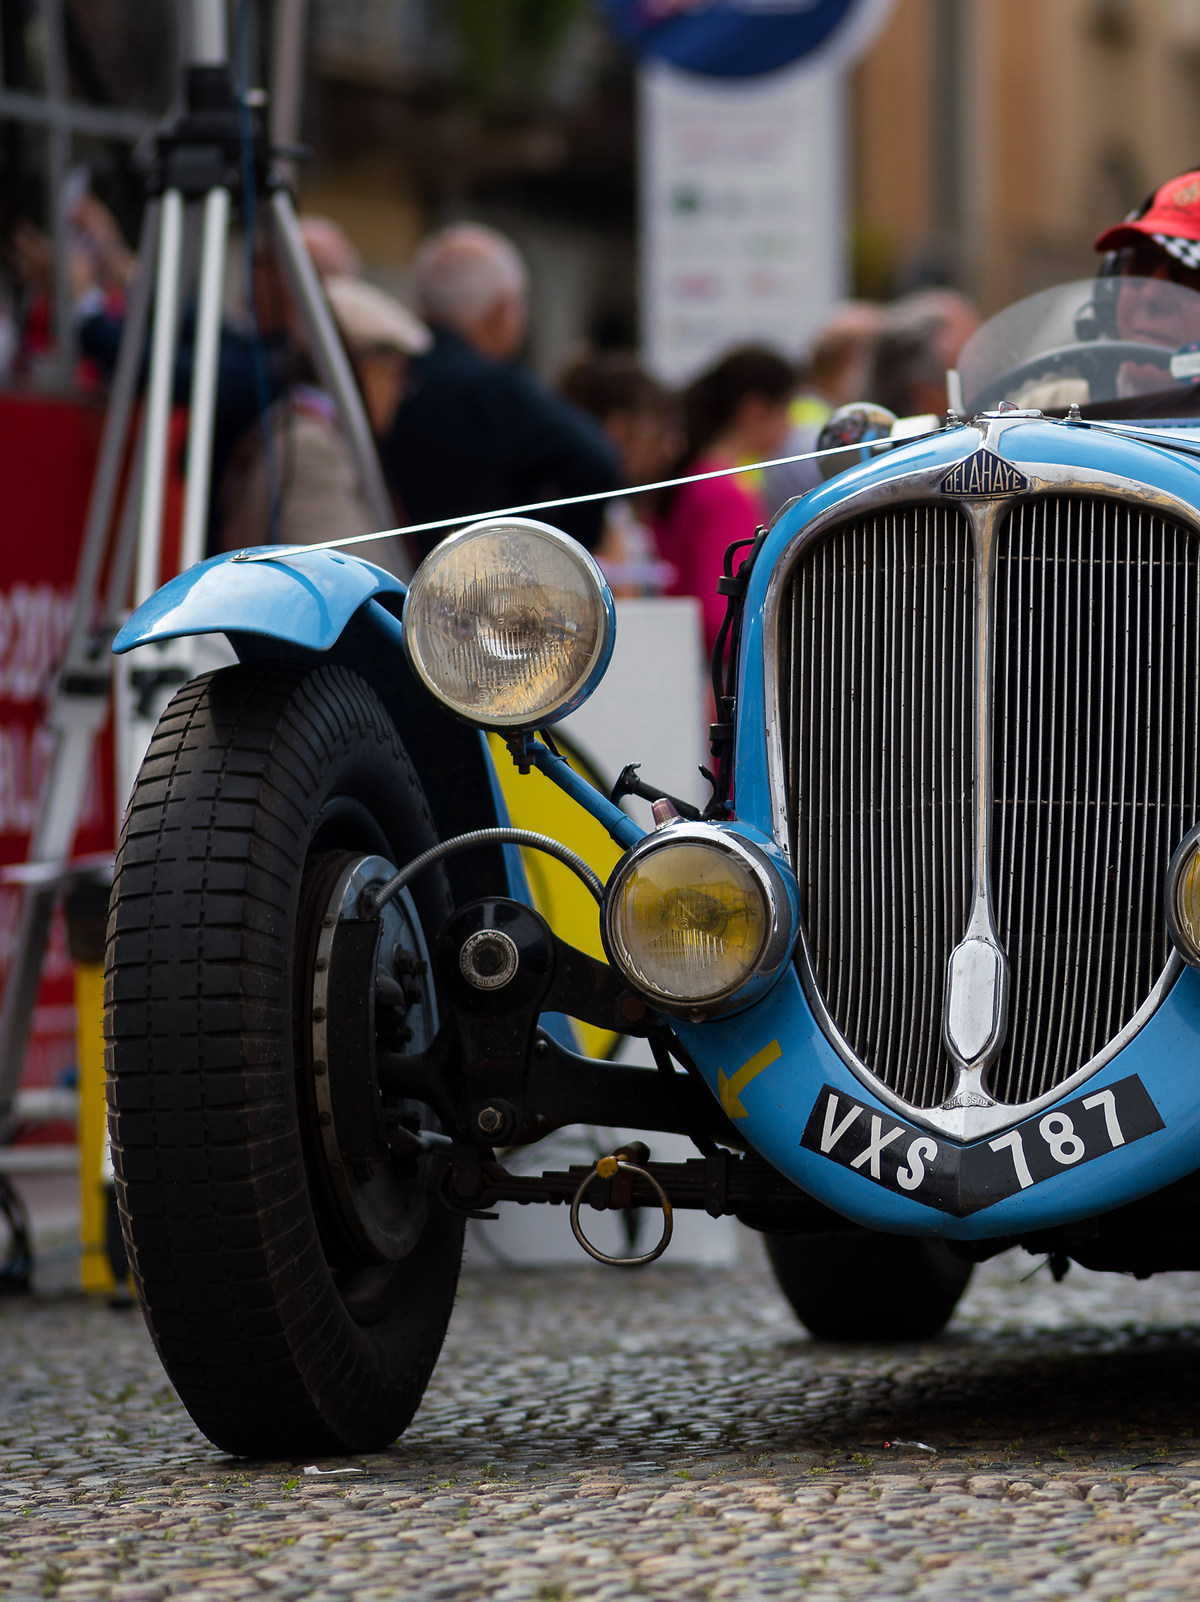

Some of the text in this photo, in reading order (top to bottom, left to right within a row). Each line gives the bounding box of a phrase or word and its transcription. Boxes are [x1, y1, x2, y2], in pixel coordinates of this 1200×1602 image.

[945, 451, 1021, 493] DELAHAYE
[820, 1089, 1126, 1190] VXS 787
